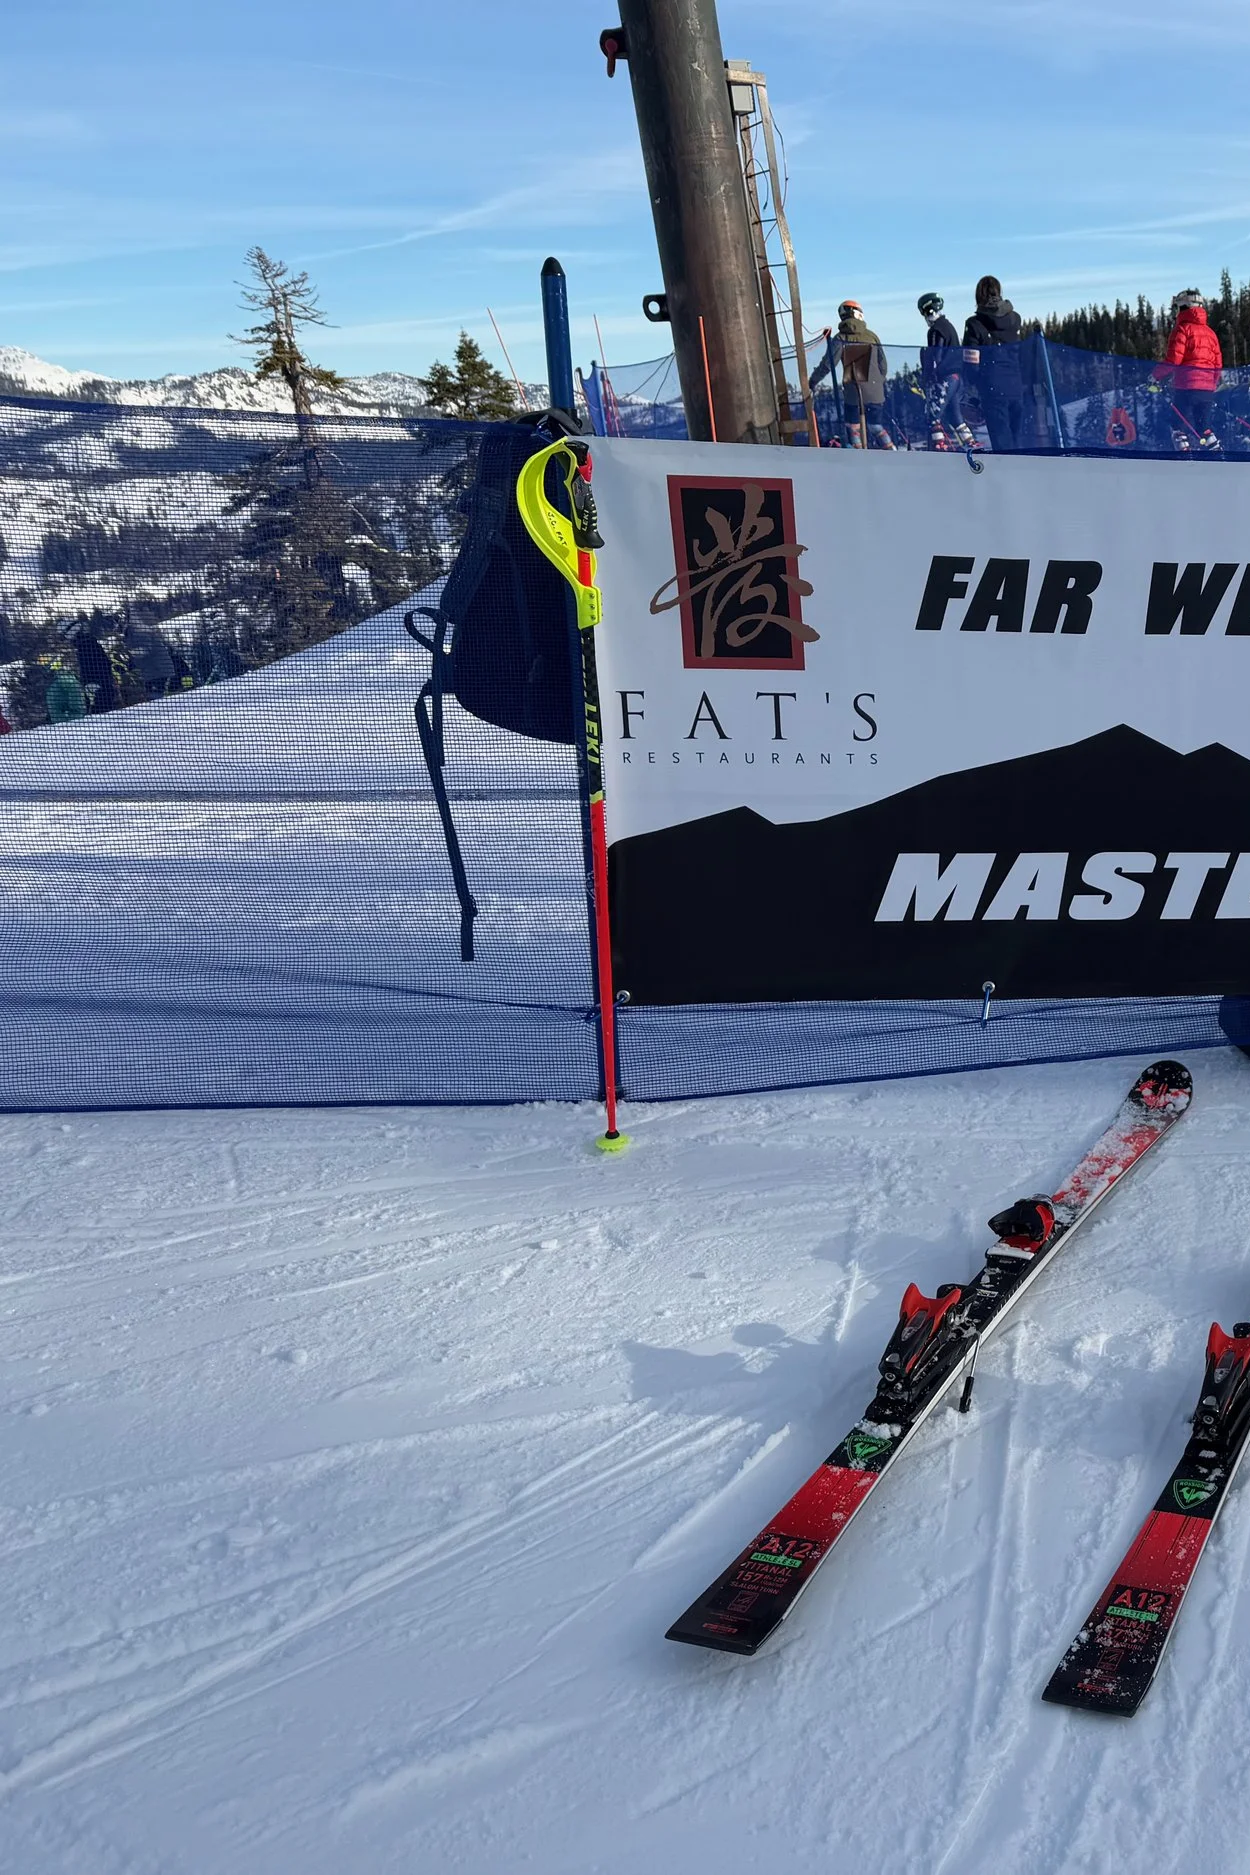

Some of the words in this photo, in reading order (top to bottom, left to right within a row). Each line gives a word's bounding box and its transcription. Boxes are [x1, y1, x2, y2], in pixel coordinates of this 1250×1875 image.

[581, 509, 590, 531] LEKI
[555, 531, 568, 546] FAT
[915, 556, 1102, 634] FAR
[615, 691, 878, 741] FAT'S
[585, 702, 600, 765] LEKI
[622, 752, 878, 765] RESTAURANTS
[761, 1537, 813, 1559] A12
[736, 1570, 764, 1582] 157
[744, 1561, 792, 1577] TITANAL
[1114, 1589, 1166, 1612] A12
